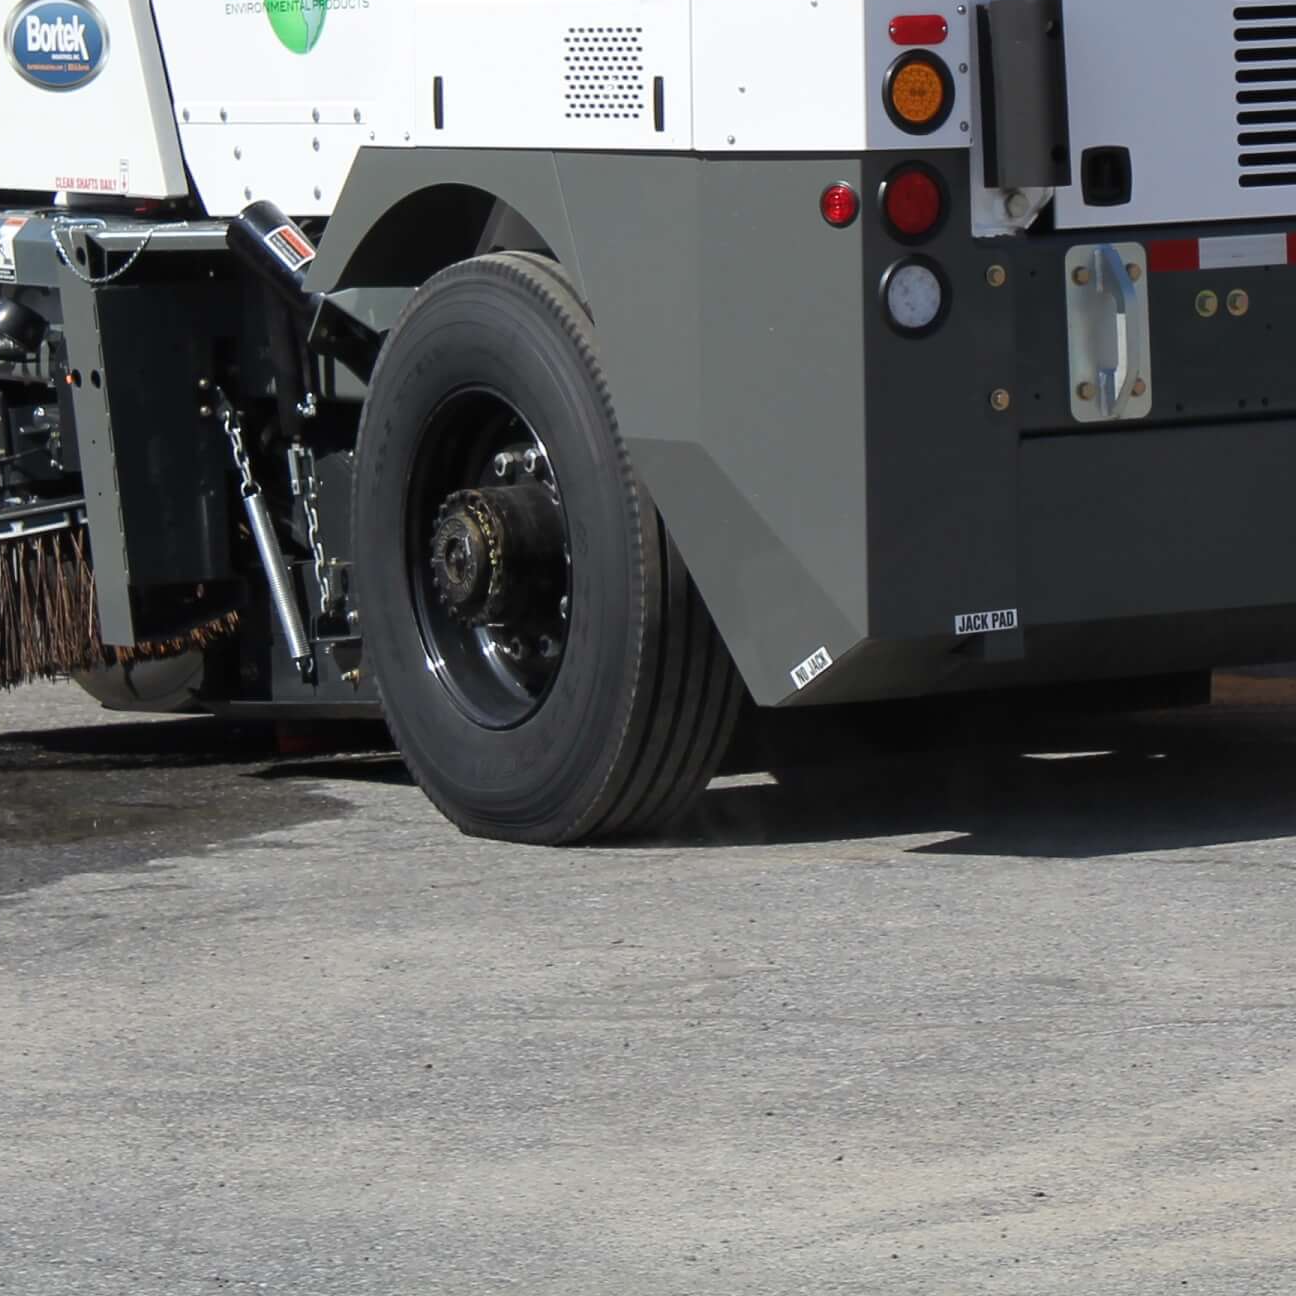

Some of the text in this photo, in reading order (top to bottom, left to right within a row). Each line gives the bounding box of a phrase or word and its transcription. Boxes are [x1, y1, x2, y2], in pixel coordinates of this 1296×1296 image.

[225, 0, 311, 16] ENVIRONMENTAL
[26, 14, 89, 61] Bortek
[55, 176, 75, 189] CLEAN
[958, 611, 1015, 633] JACK PAD
[795, 651, 828, 685] NO JACK
